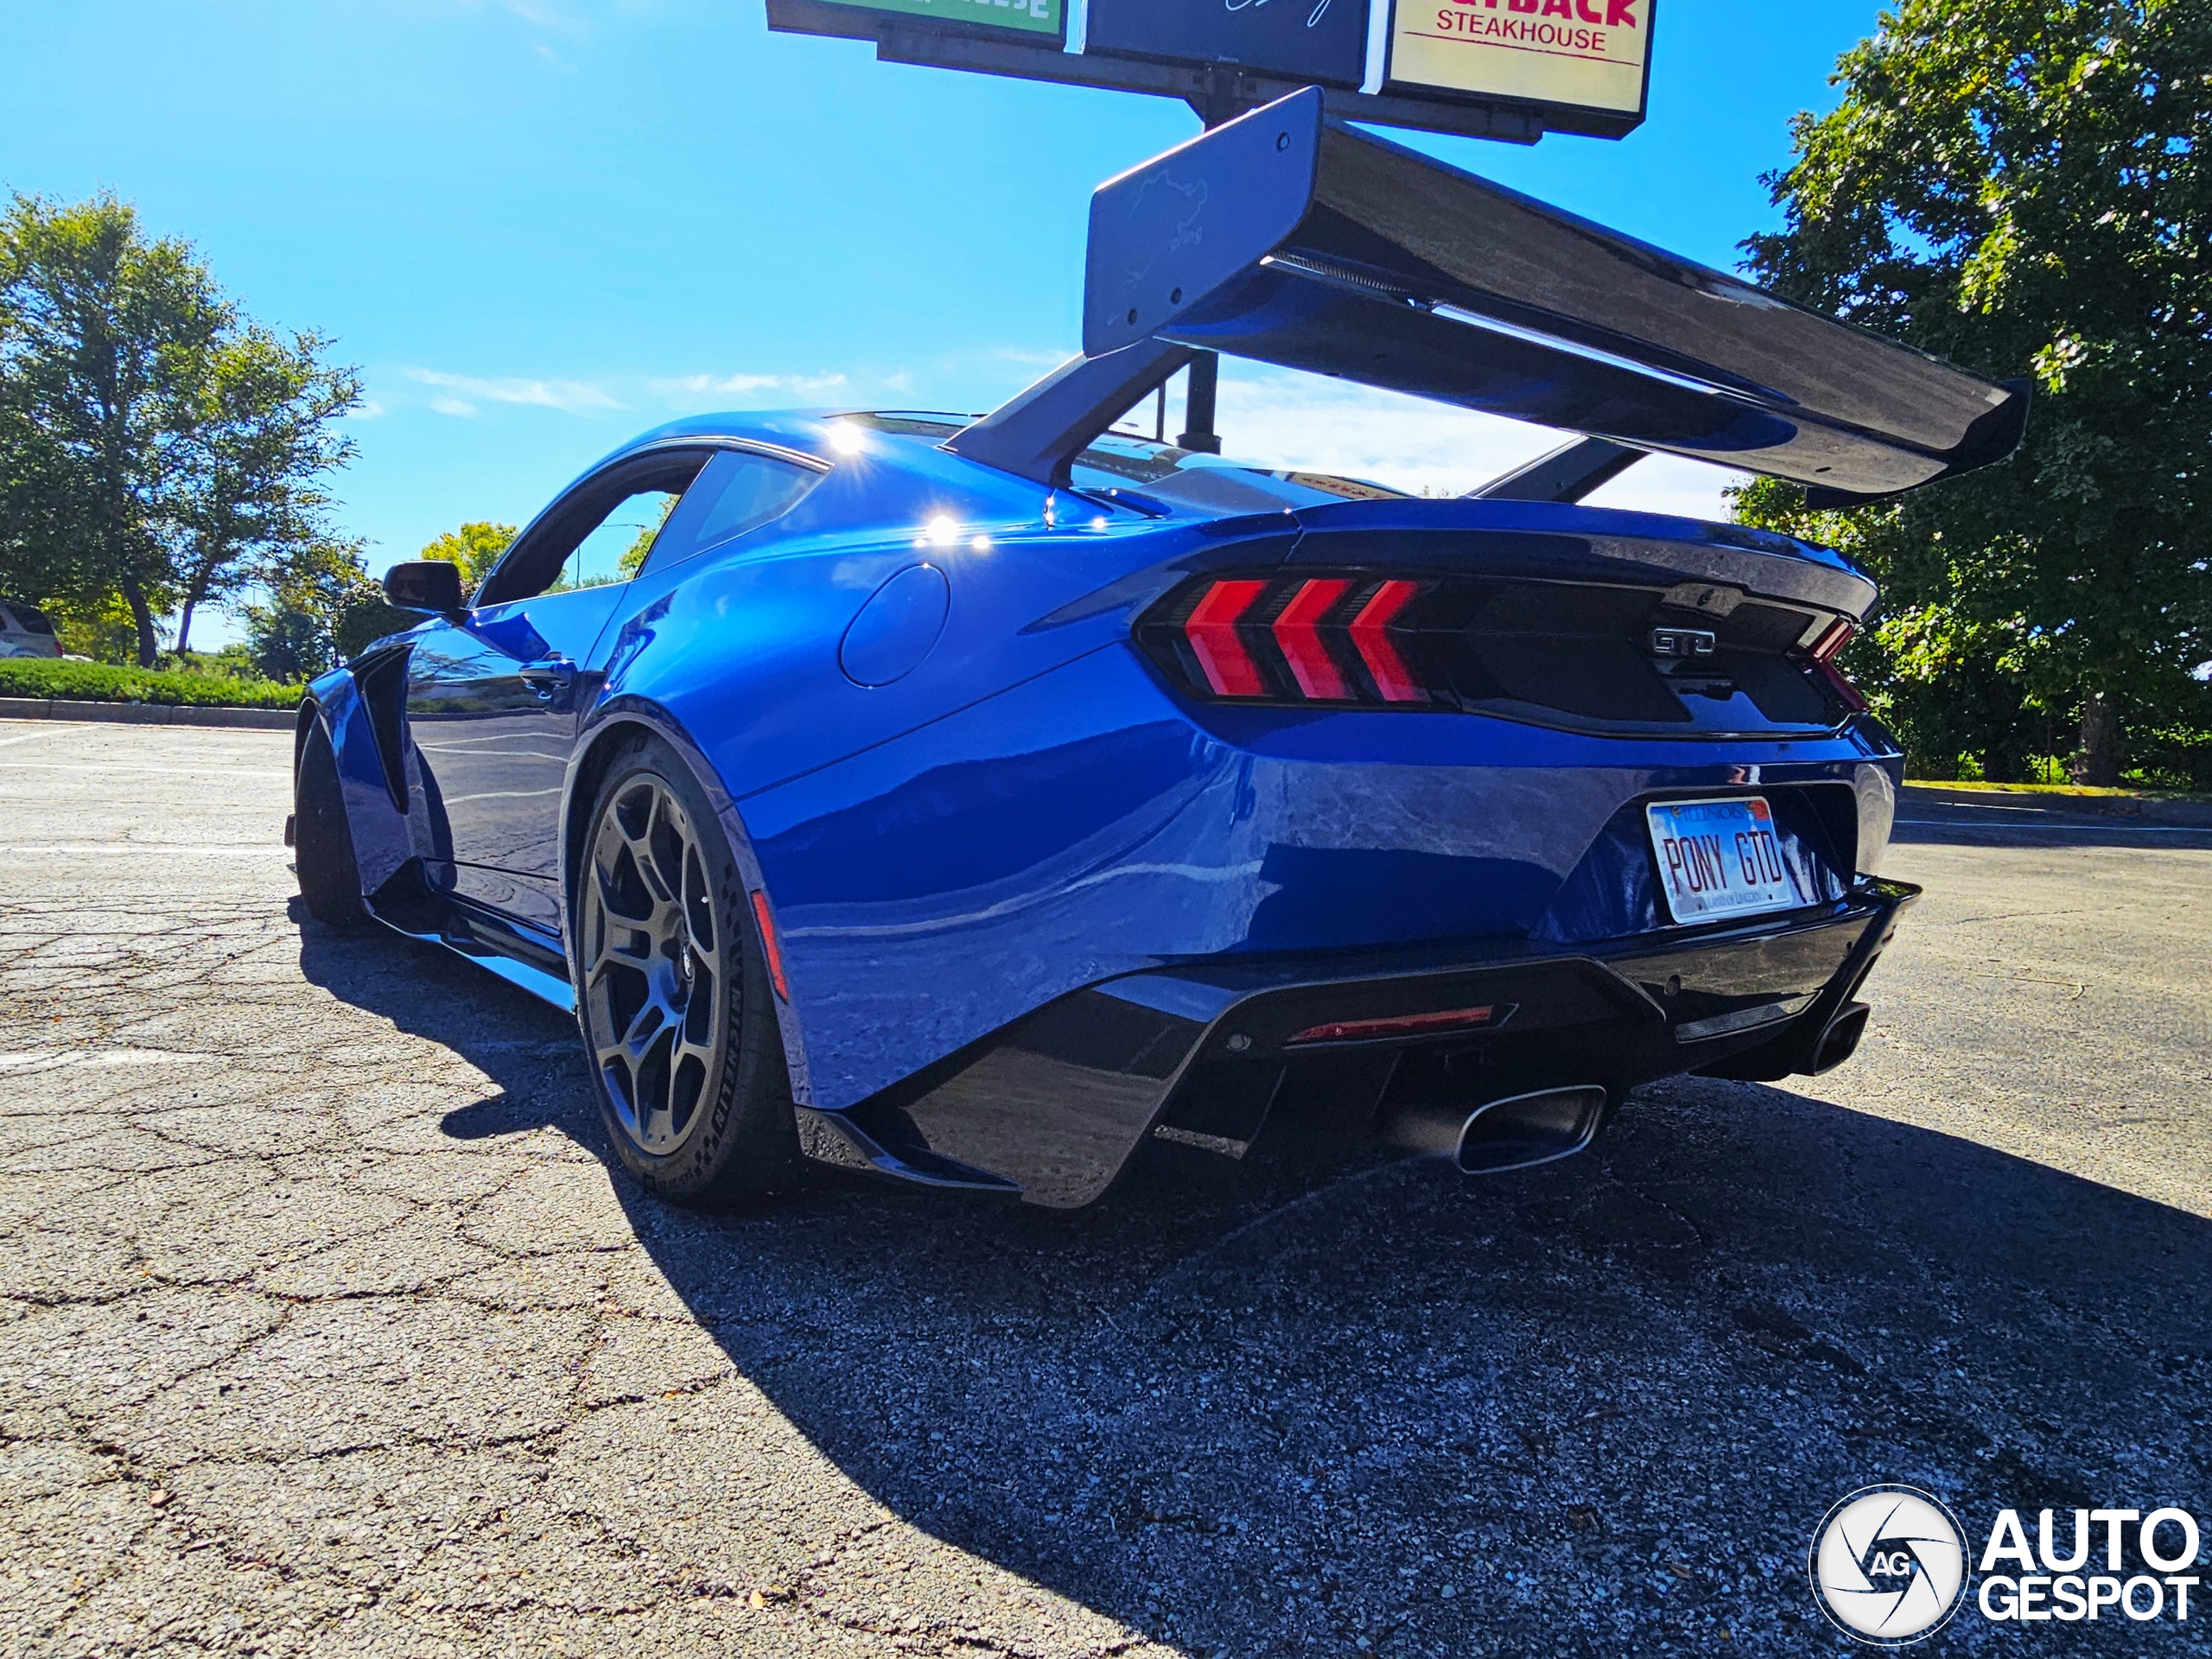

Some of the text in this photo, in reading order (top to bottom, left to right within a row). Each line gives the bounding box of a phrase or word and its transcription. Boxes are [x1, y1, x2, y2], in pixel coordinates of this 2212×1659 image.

[1436, 10, 1605, 51] STEAKHOUSE
[1662, 830, 1783, 894] PONY GTD
